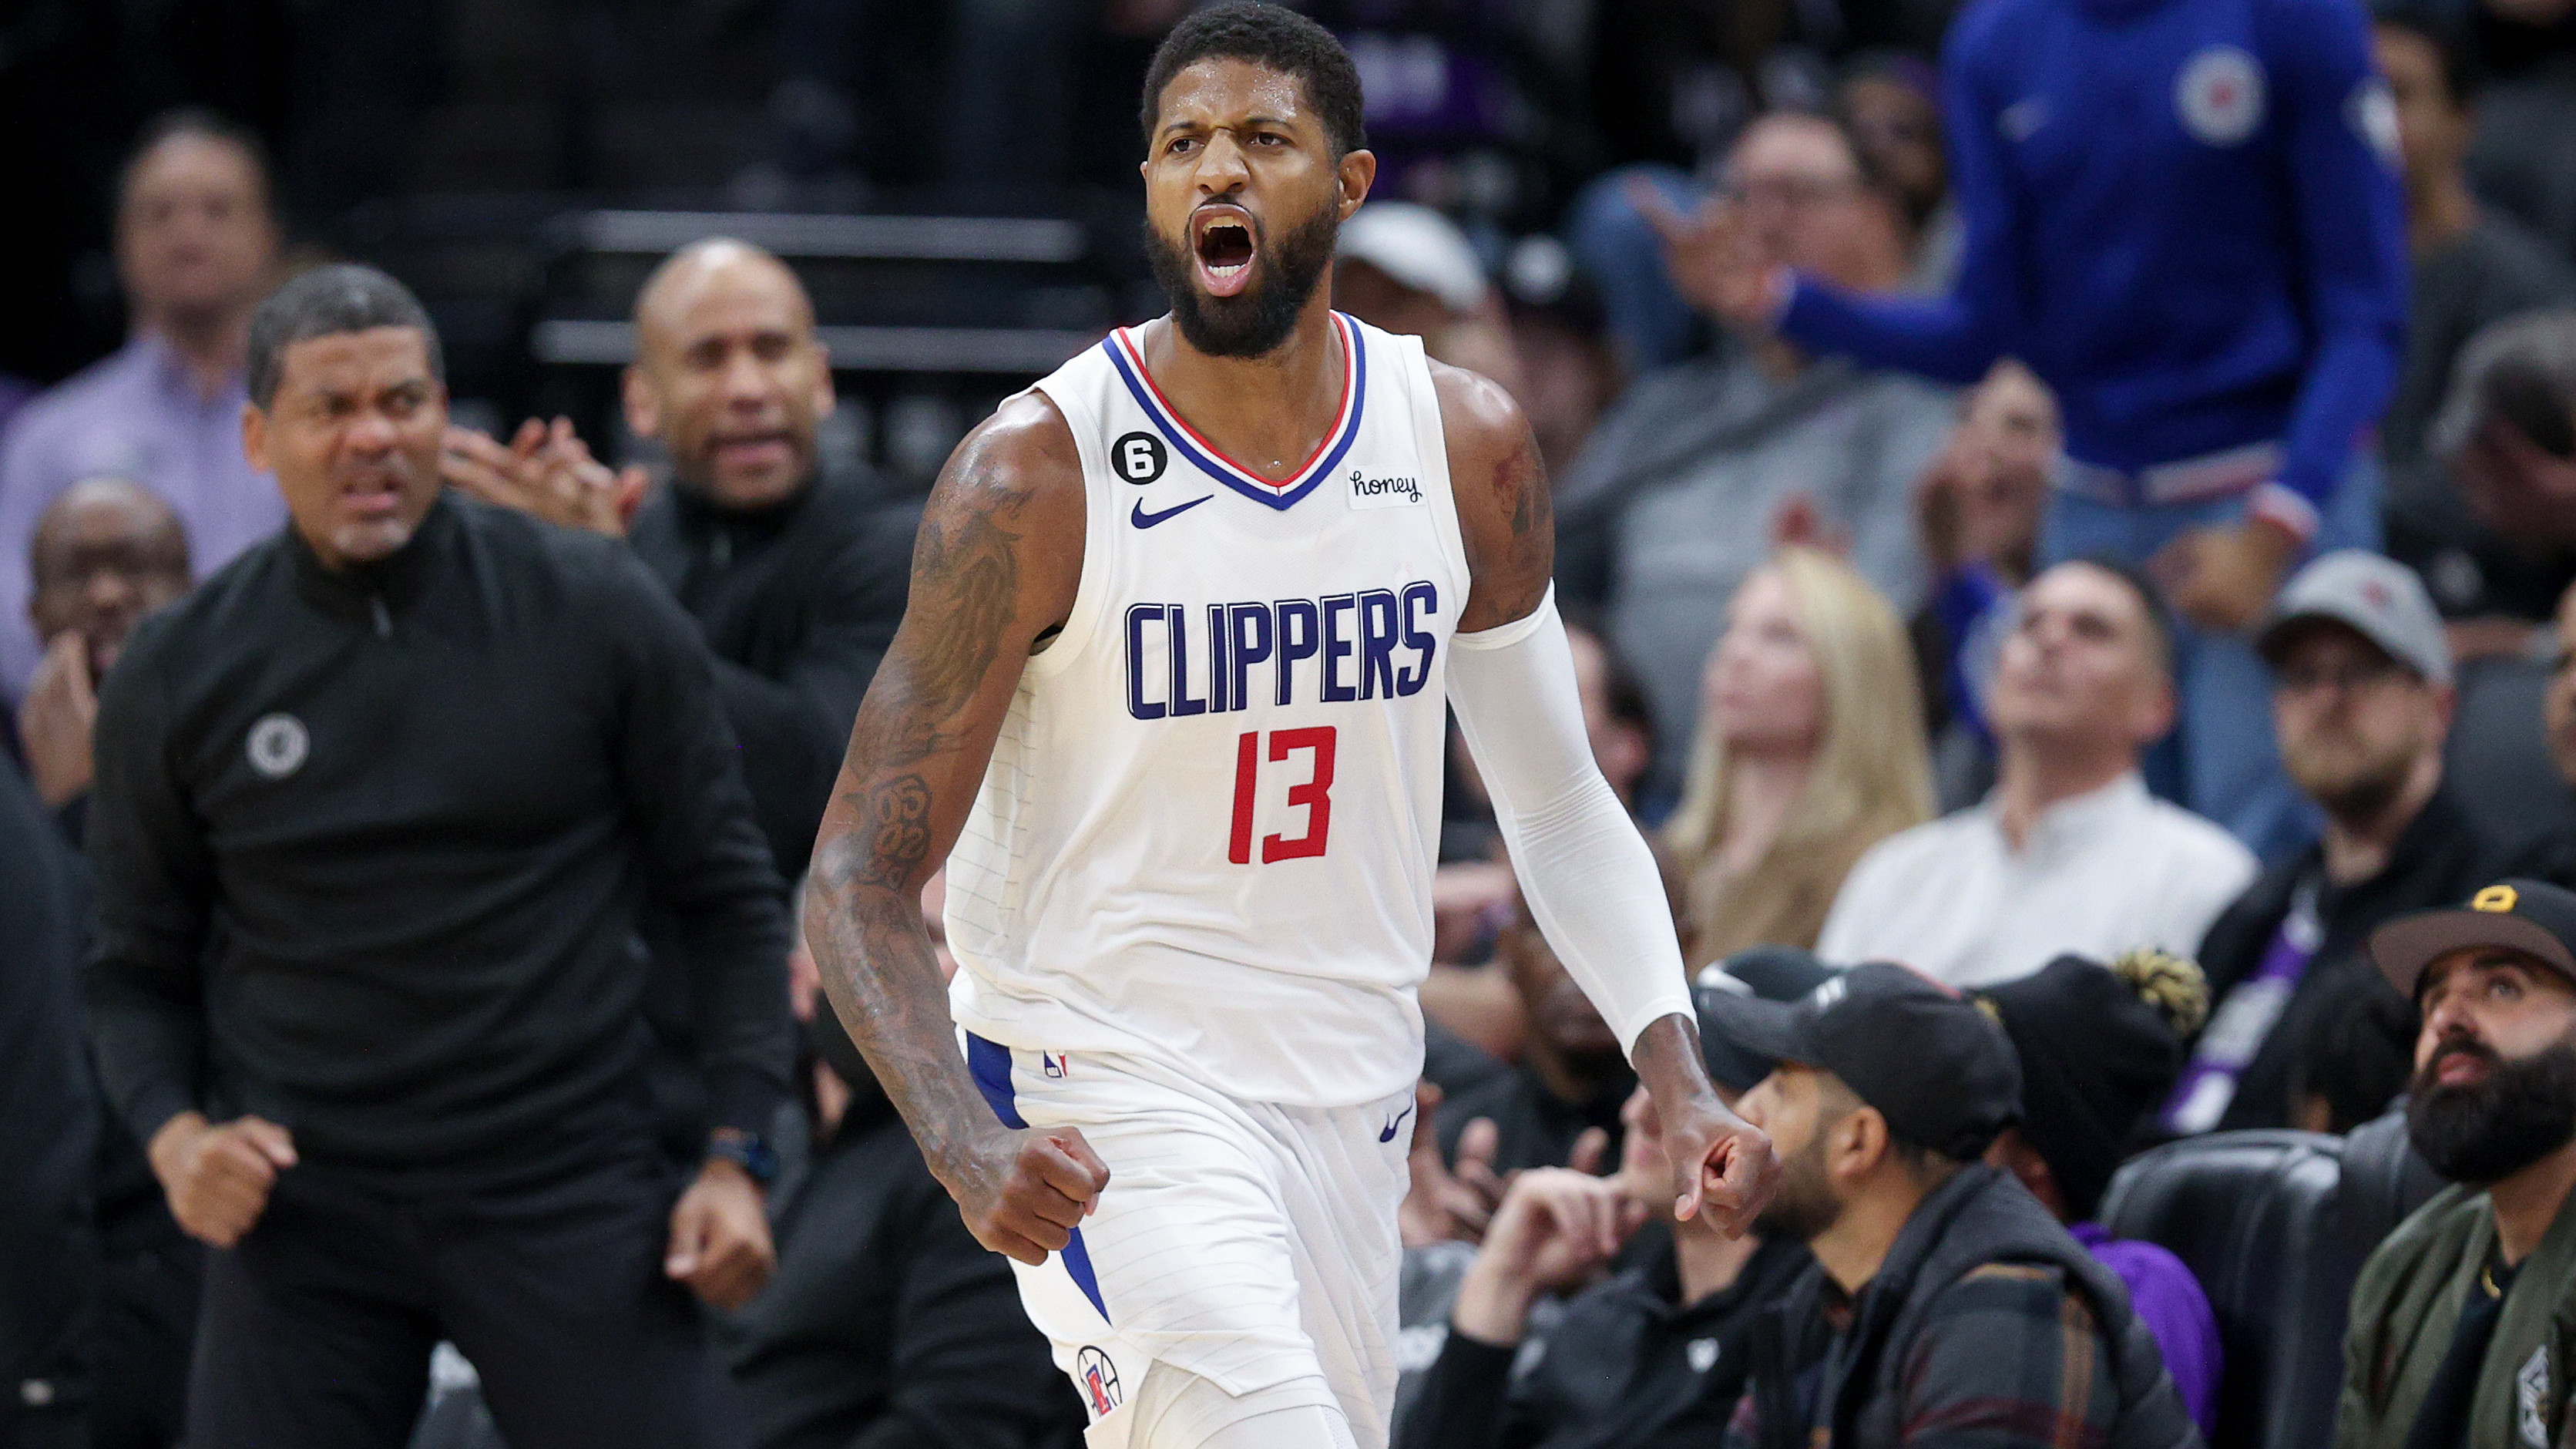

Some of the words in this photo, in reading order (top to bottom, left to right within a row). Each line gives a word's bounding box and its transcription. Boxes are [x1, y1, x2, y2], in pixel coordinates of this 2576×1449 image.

[1123, 438, 1155, 479] 6
[1350, 470, 1423, 503] honey
[1125, 580, 1437, 721] CLIPPERS
[1228, 726, 1337, 865] 13
